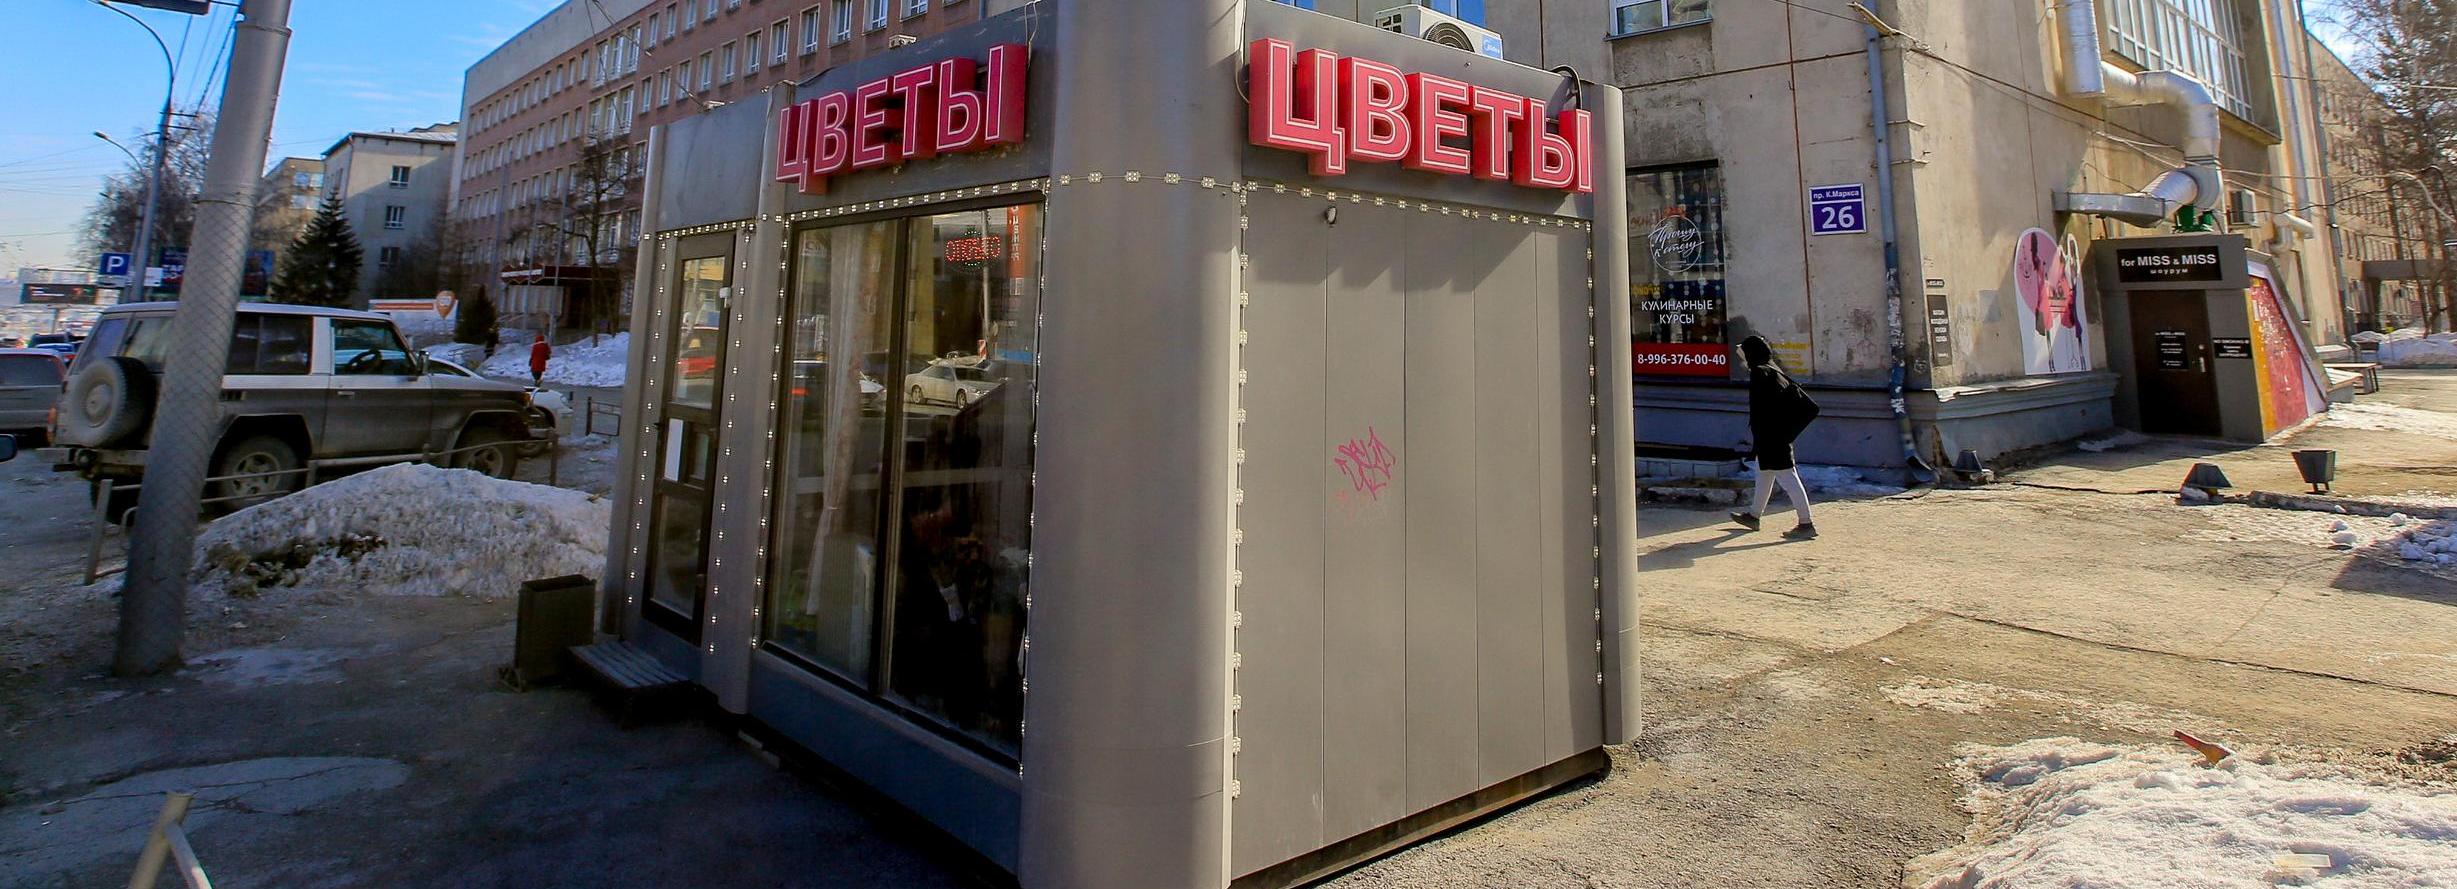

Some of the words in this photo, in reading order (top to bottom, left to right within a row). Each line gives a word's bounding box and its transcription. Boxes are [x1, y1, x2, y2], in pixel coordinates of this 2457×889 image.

[776, 44, 1014, 194] ЦВЕТЫ
[1255, 39, 1592, 193] ЦВЕТЫ
[1826, 190, 1859, 198] К.Маркса
[1821, 205, 1855, 229] 26
[106, 256, 124, 272] P
[2121, 258, 2135, 267] for
[2137, 255, 2170, 266] MISS
[2181, 254, 2217, 265] MISS
[1641, 299, 1713, 311] КУЛИНАРНЫЕ
[1659, 313, 1695, 324] КУРСЫ
[1637, 353, 1727, 365] 8-996-376-00-40
